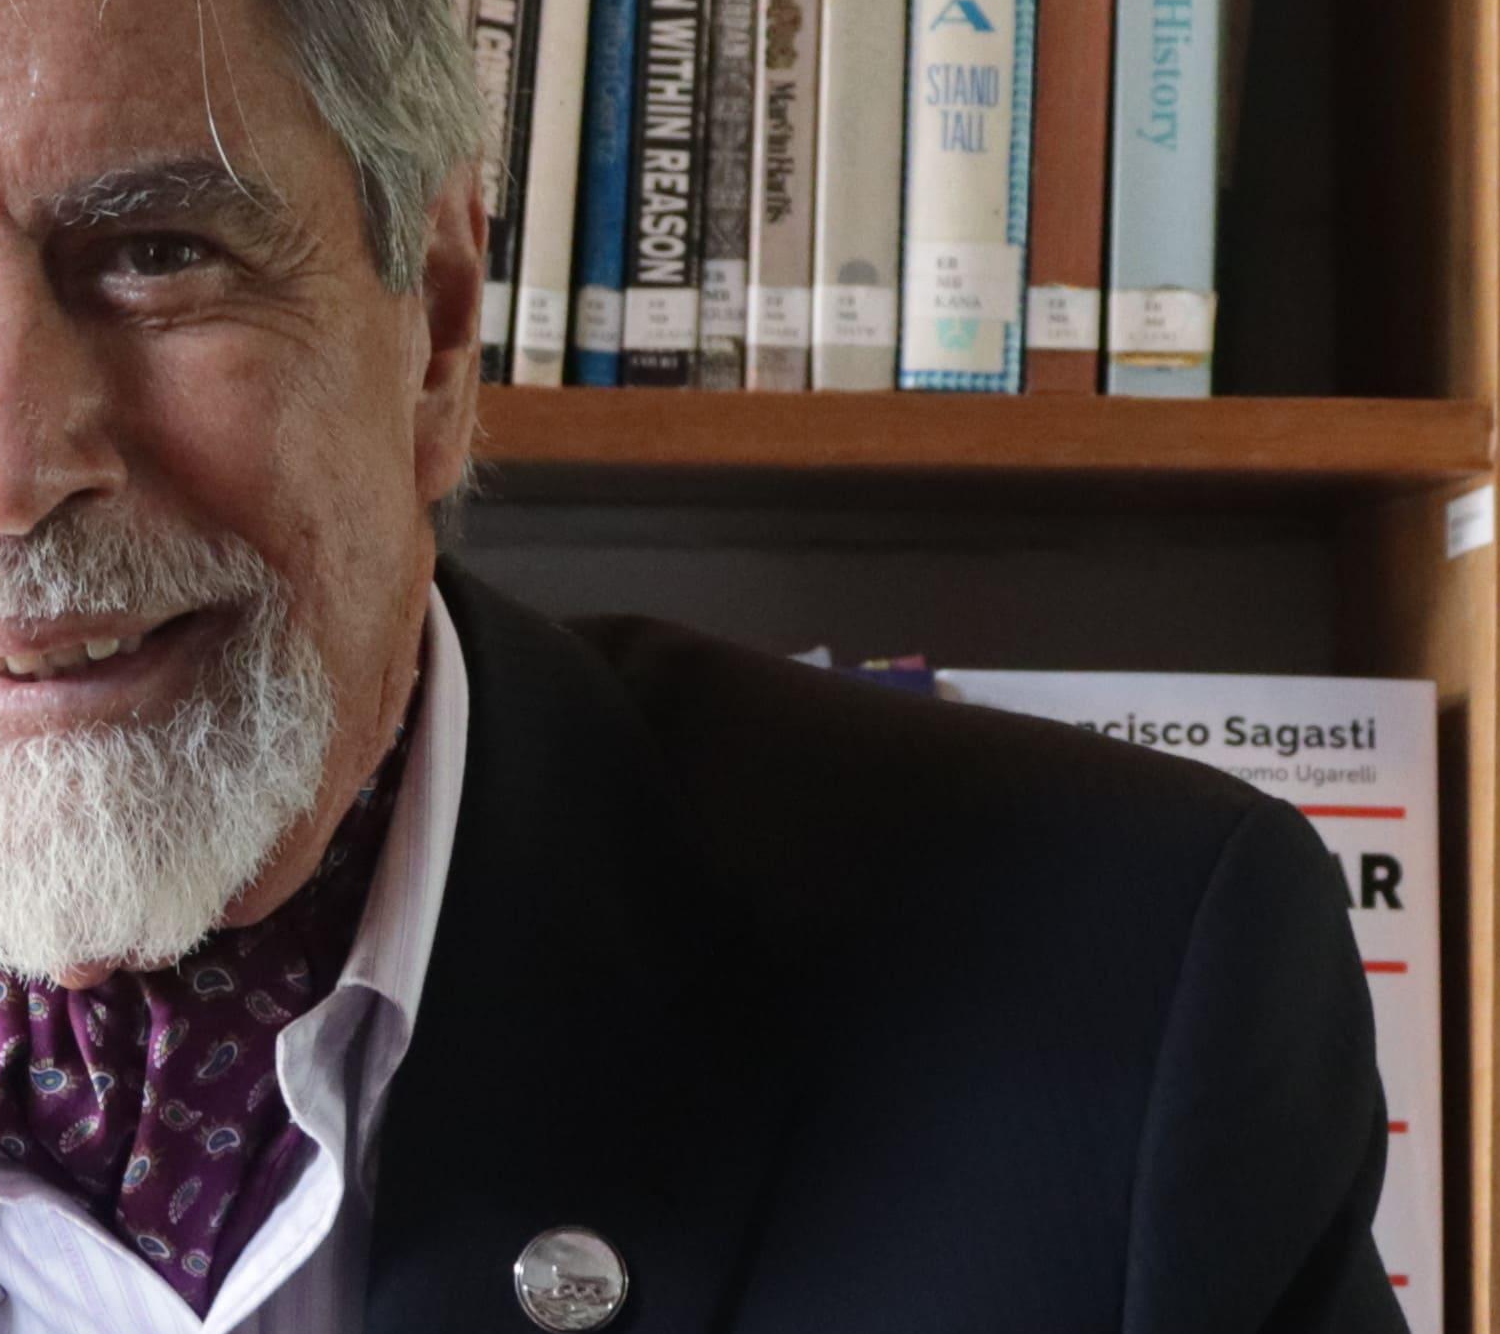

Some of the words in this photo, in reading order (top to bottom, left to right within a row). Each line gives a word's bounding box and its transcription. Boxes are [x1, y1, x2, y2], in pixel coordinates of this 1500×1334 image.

[648, 17, 696, 140] WITHIN
[640, 149, 689, 285] REASON
[1225, 715, 1378, 757] Sagasti
[1294, 763, 1378, 787] Ugarelli
